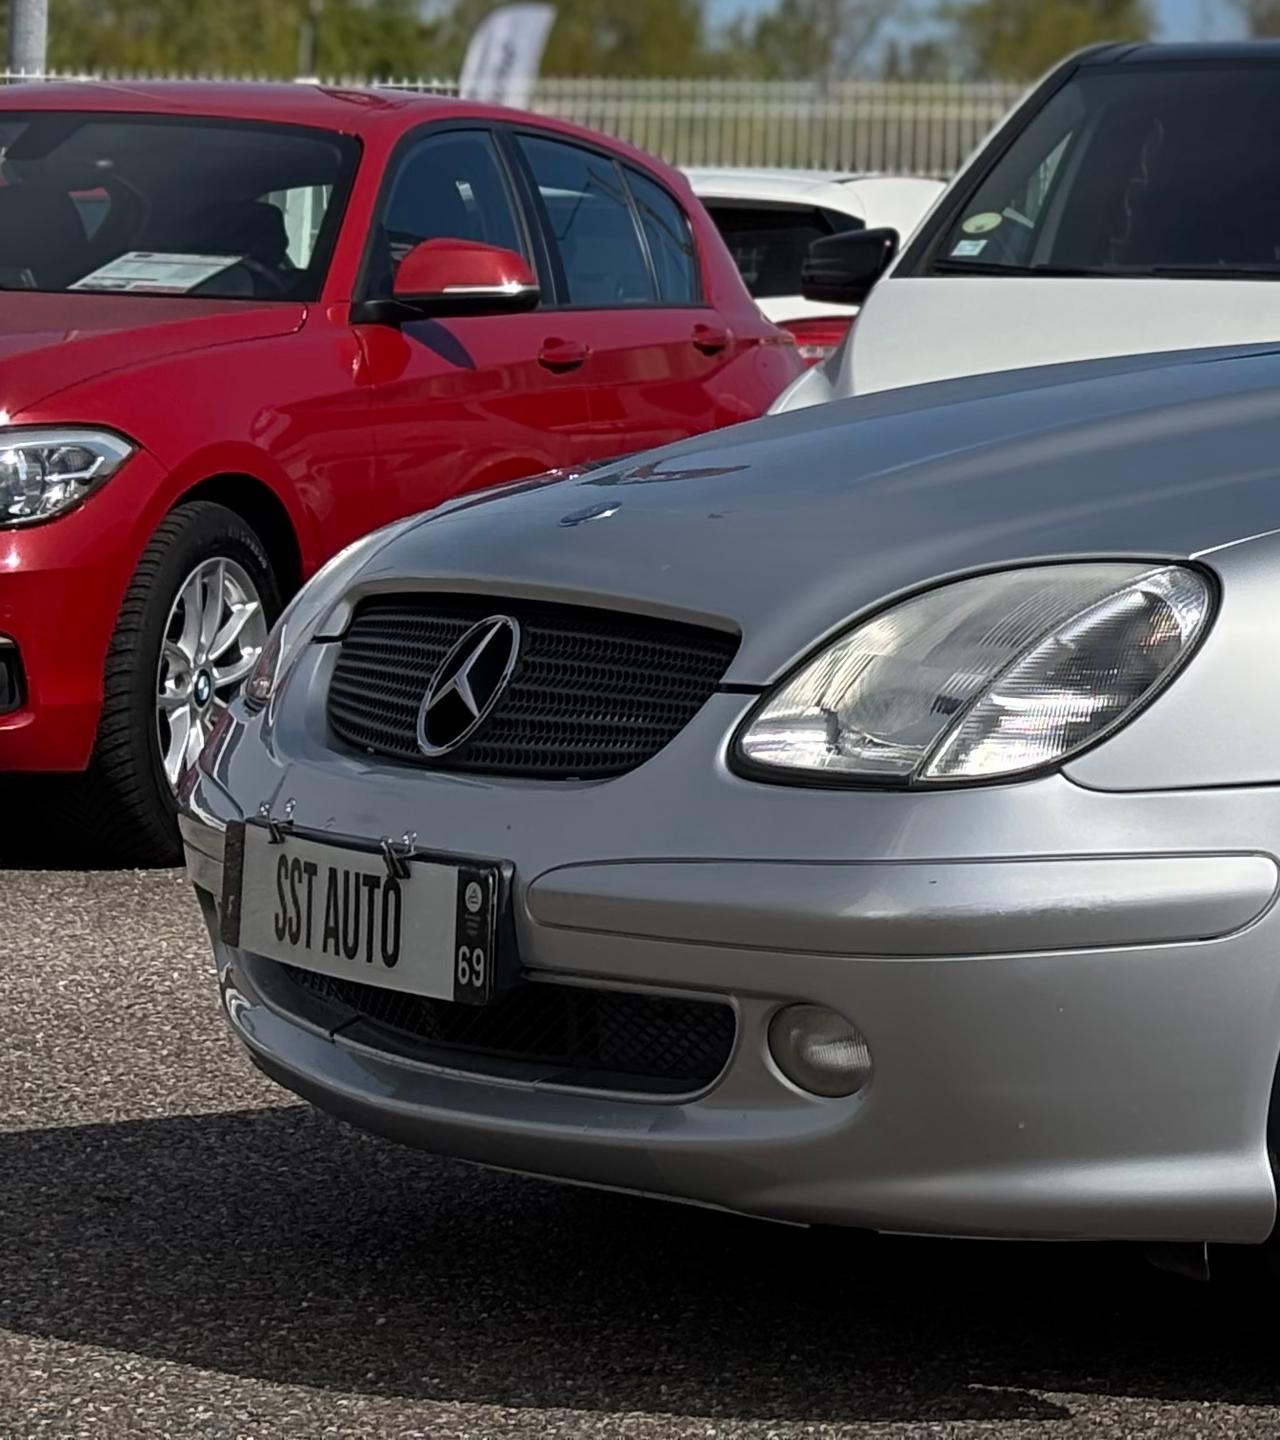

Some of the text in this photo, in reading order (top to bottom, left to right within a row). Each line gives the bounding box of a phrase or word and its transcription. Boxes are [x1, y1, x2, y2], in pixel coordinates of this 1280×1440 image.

[274, 853, 403, 968] SST AUTO
[458, 945, 485, 987] 69
